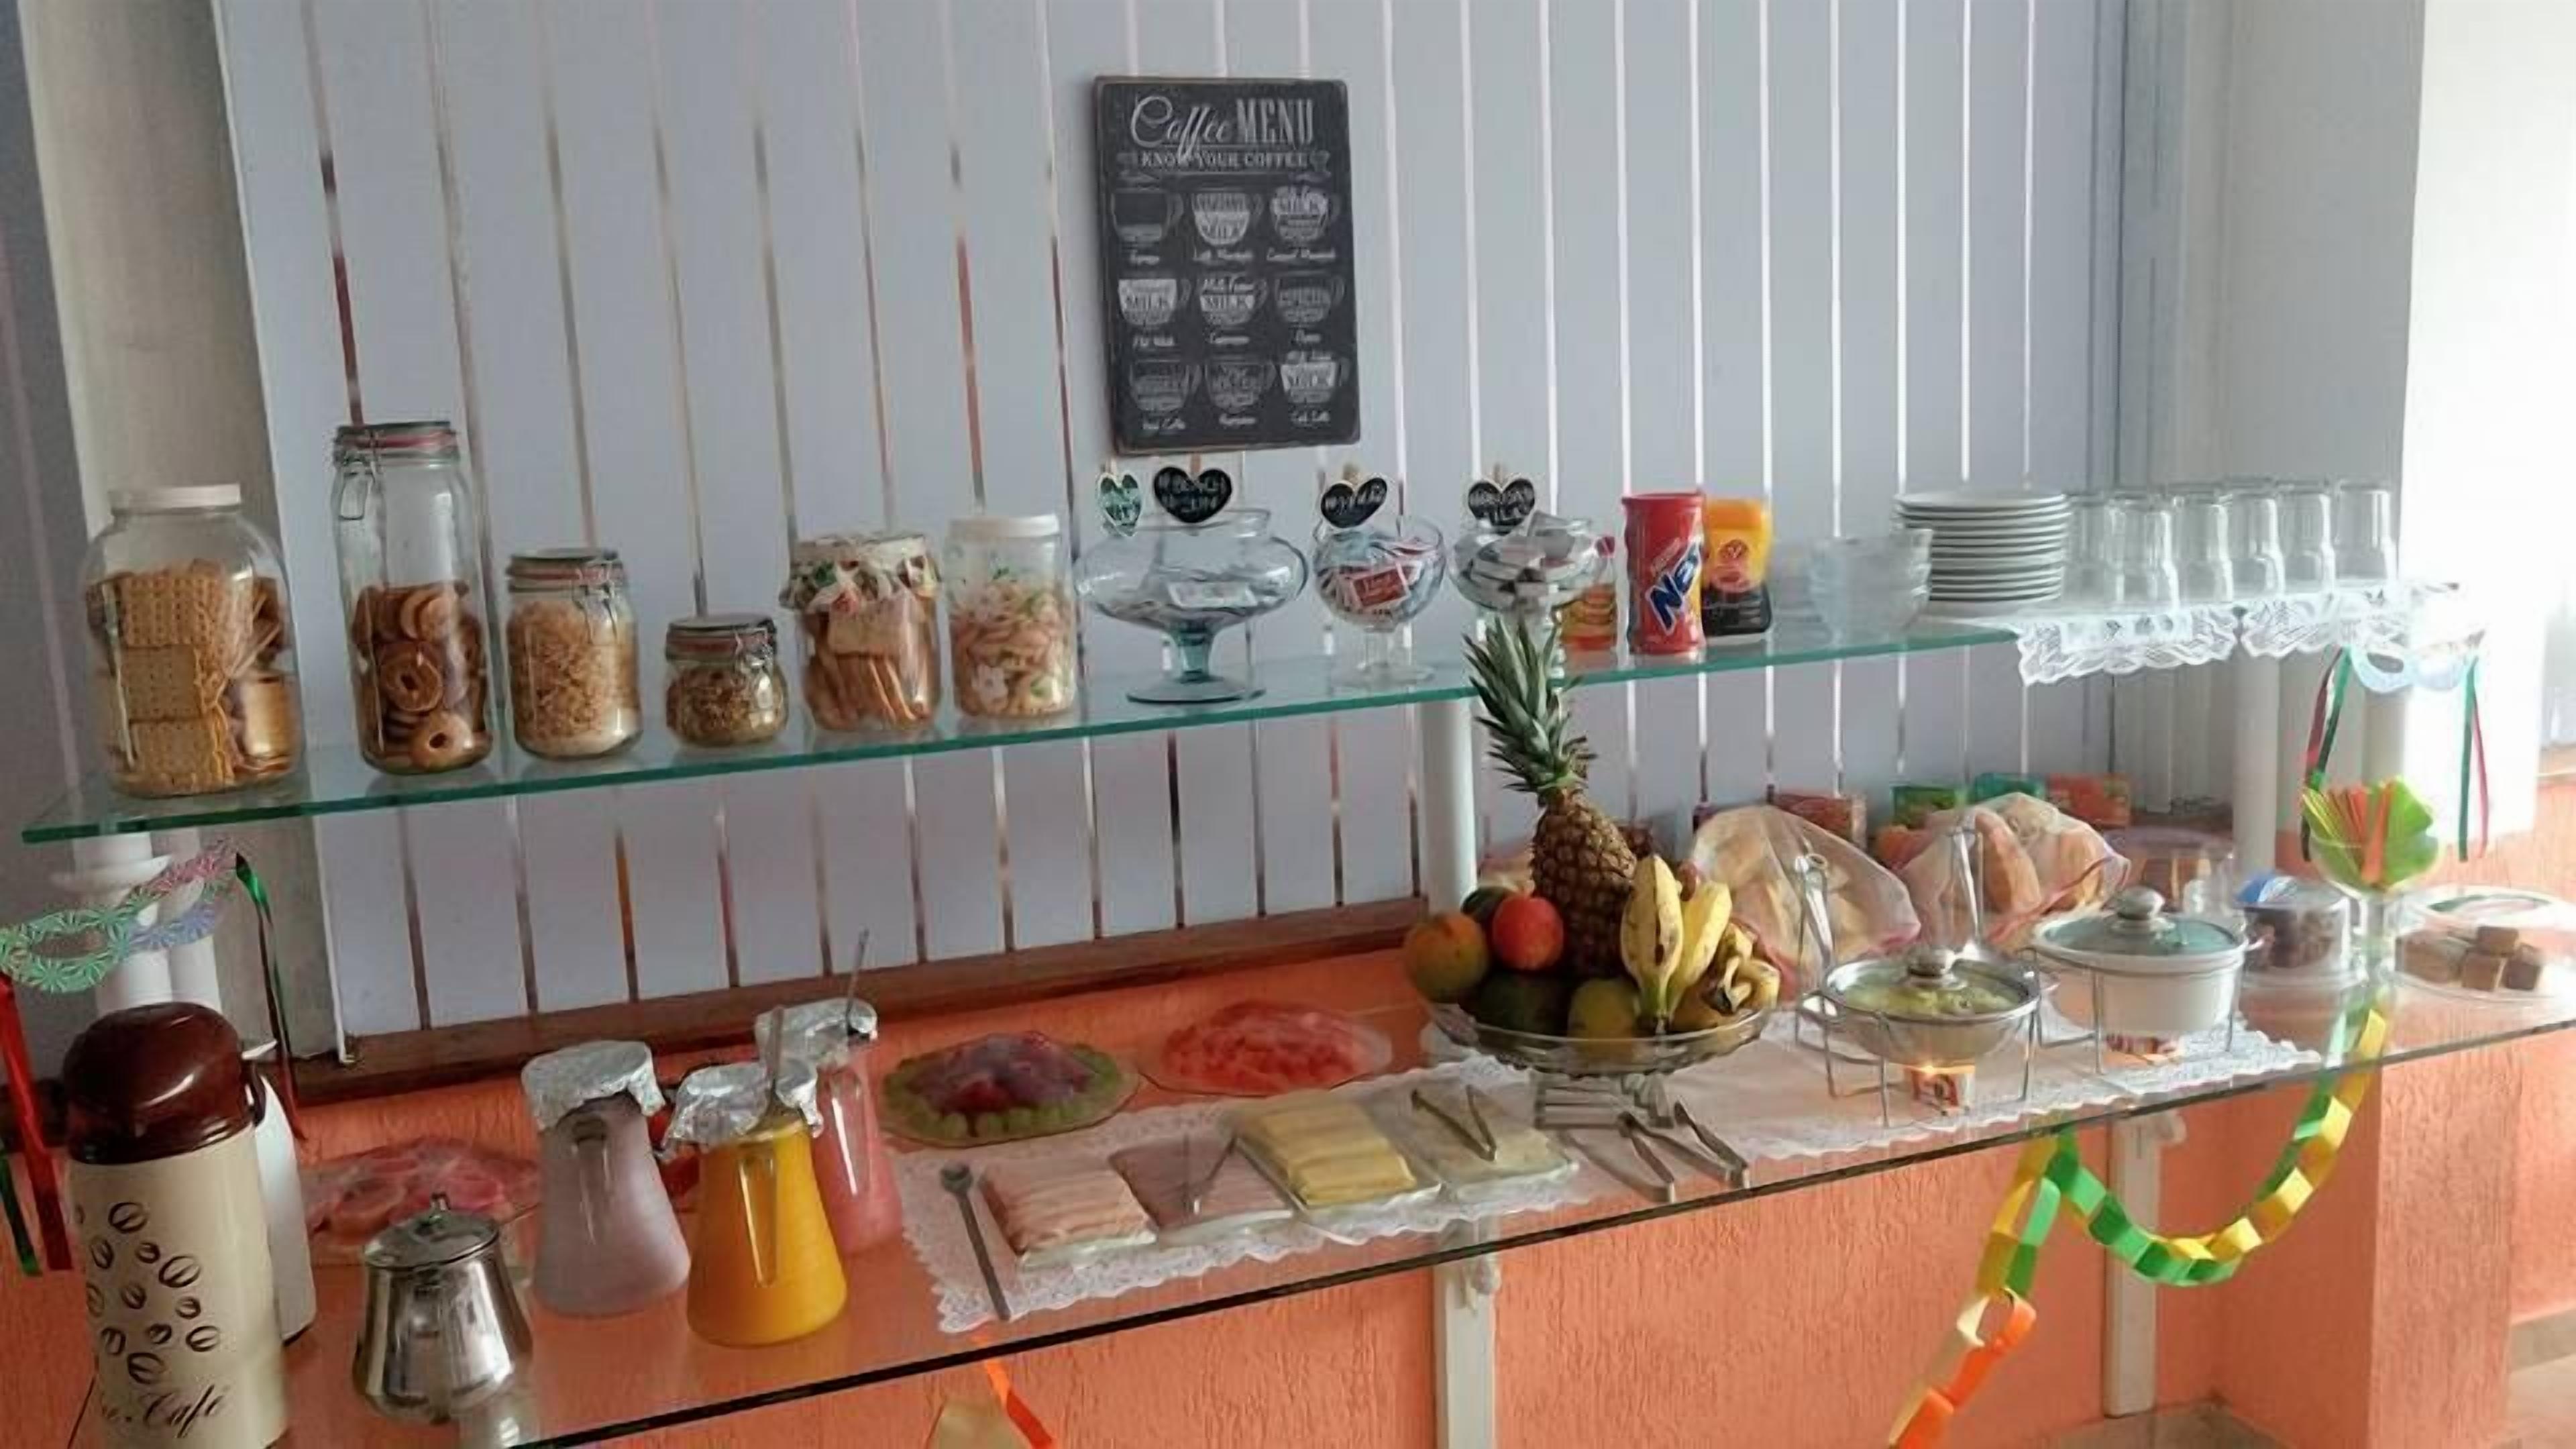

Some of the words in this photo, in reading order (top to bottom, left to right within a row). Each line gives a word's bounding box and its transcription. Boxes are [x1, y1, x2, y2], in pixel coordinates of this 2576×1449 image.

[1130, 95, 1232, 163] Coffee
[1236, 98, 1313, 150] MENU
[1195, 151, 1240, 168] YOUR
[1244, 151, 1308, 167] COFFEE
